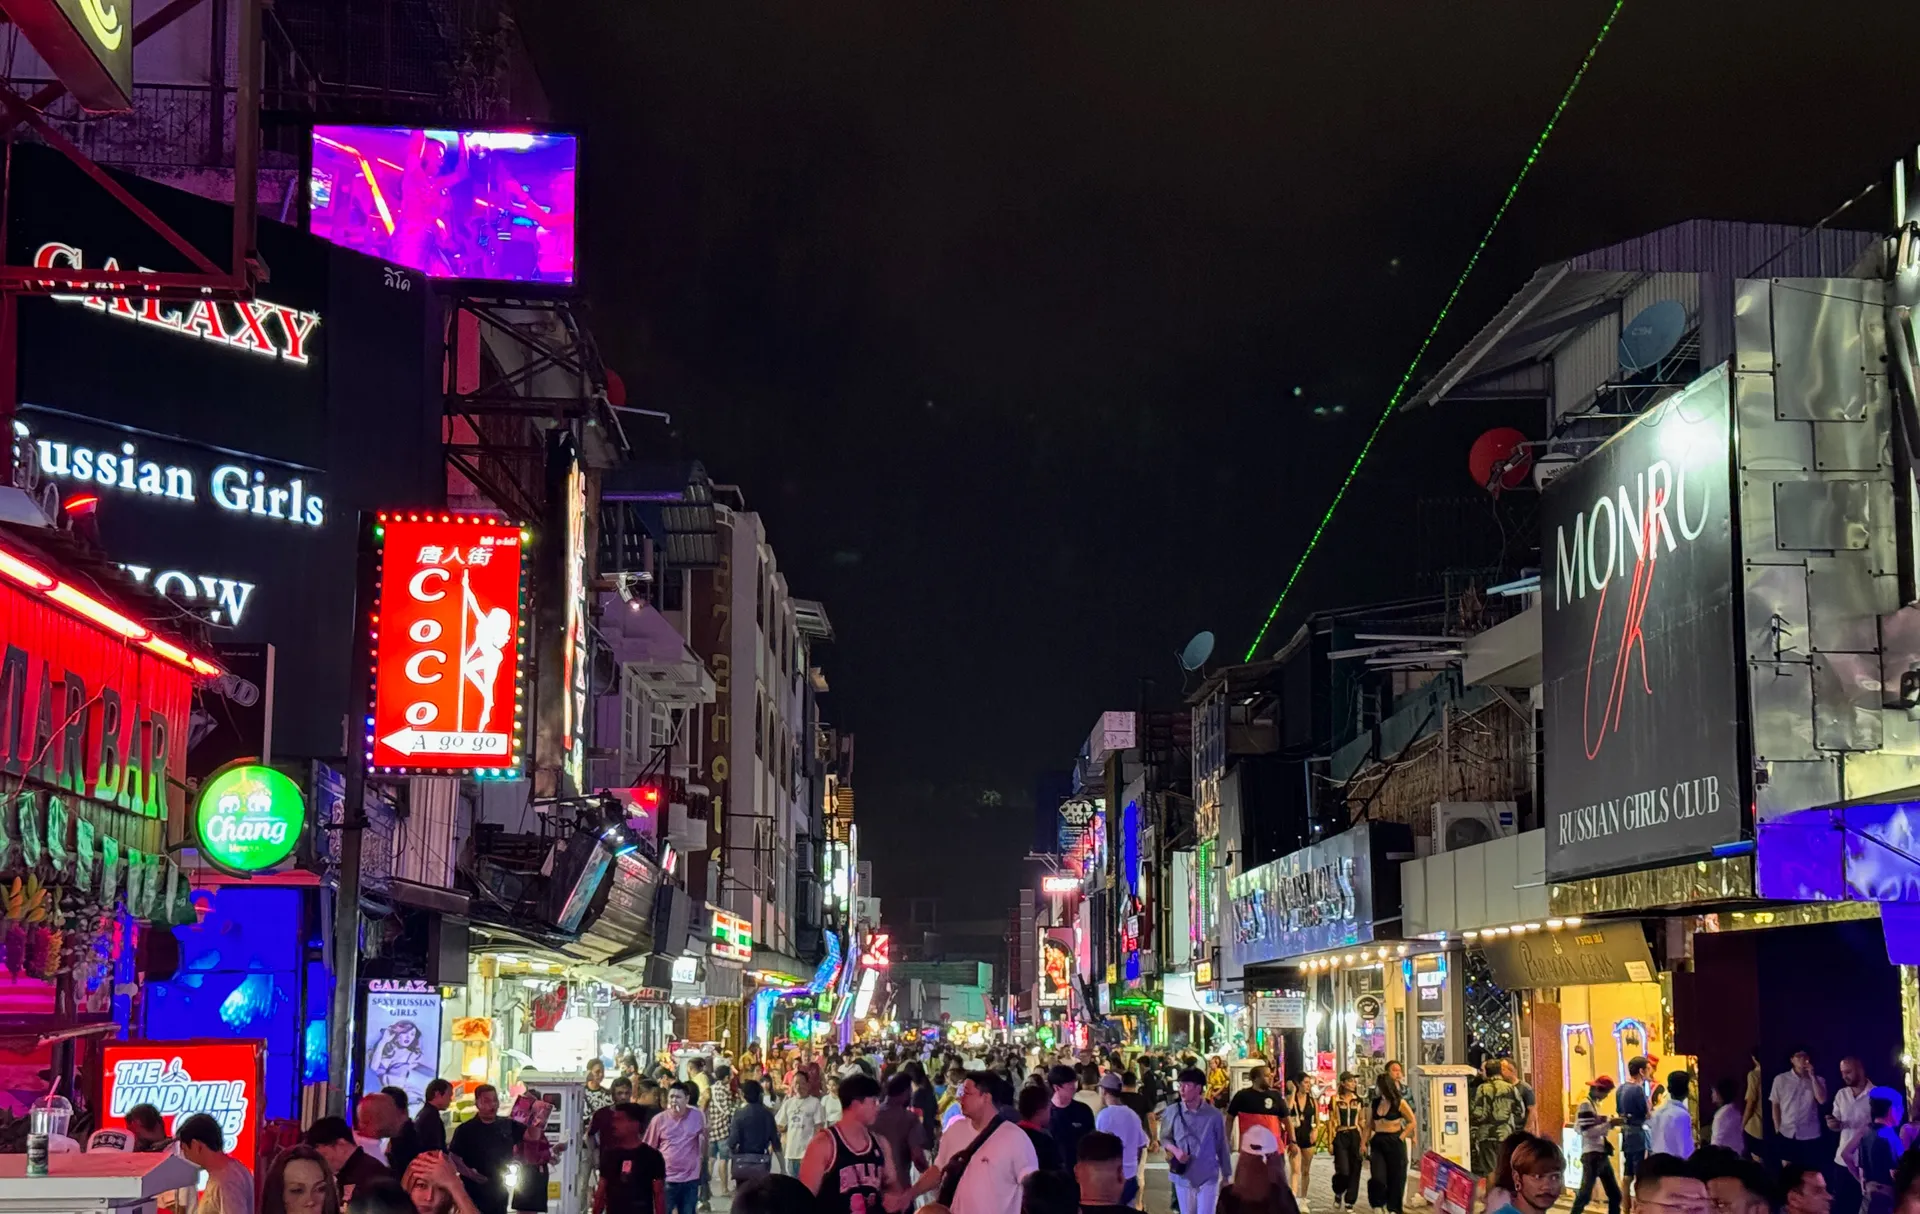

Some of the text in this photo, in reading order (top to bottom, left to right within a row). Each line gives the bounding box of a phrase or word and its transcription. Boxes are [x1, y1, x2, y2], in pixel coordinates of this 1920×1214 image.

[13, 421, 325, 526] ussian Girls
[416, 546, 494, 566] 唐人街
[95, 685, 169, 821] BAR
[412, 734, 497, 751] A go go
[1558, 775, 1720, 846] RUSSIAN GIRLS CLUB
[207, 815, 287, 844] Chang
[390, 1008, 418, 1017] GIRLS
[397, 998, 436, 1007] RUSSIAN
[117, 1061, 162, 1086] THE
[113, 1082, 246, 1114] WINDMILL
[1264, 1097, 1273, 1109] 9
